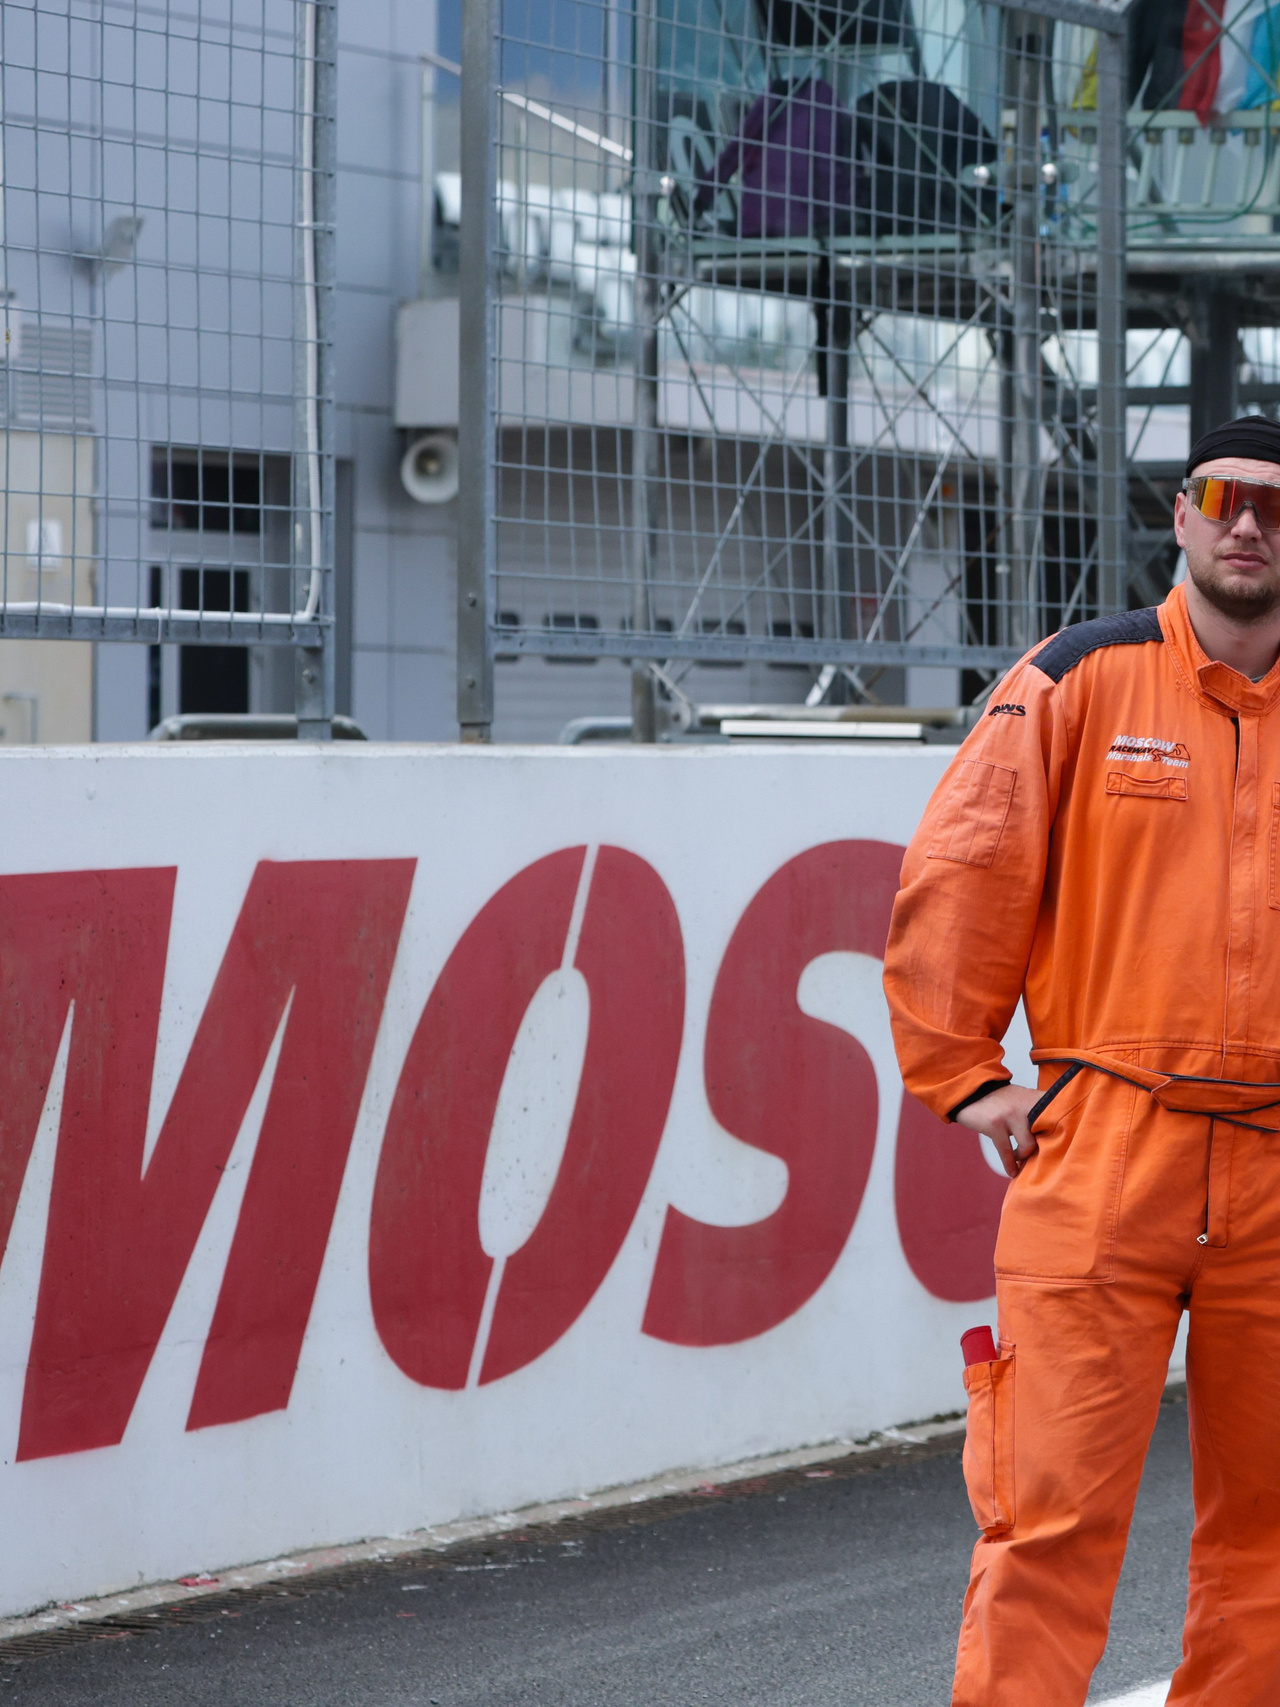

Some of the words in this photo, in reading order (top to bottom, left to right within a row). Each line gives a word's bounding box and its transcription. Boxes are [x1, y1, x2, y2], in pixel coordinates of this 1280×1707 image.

[1109, 745, 1153, 754] RACEWAY
[1113, 734, 1176, 752] MOSCOW
[1106, 752, 1153, 762] Marshals
[1161, 755, 1189, 768] Team
